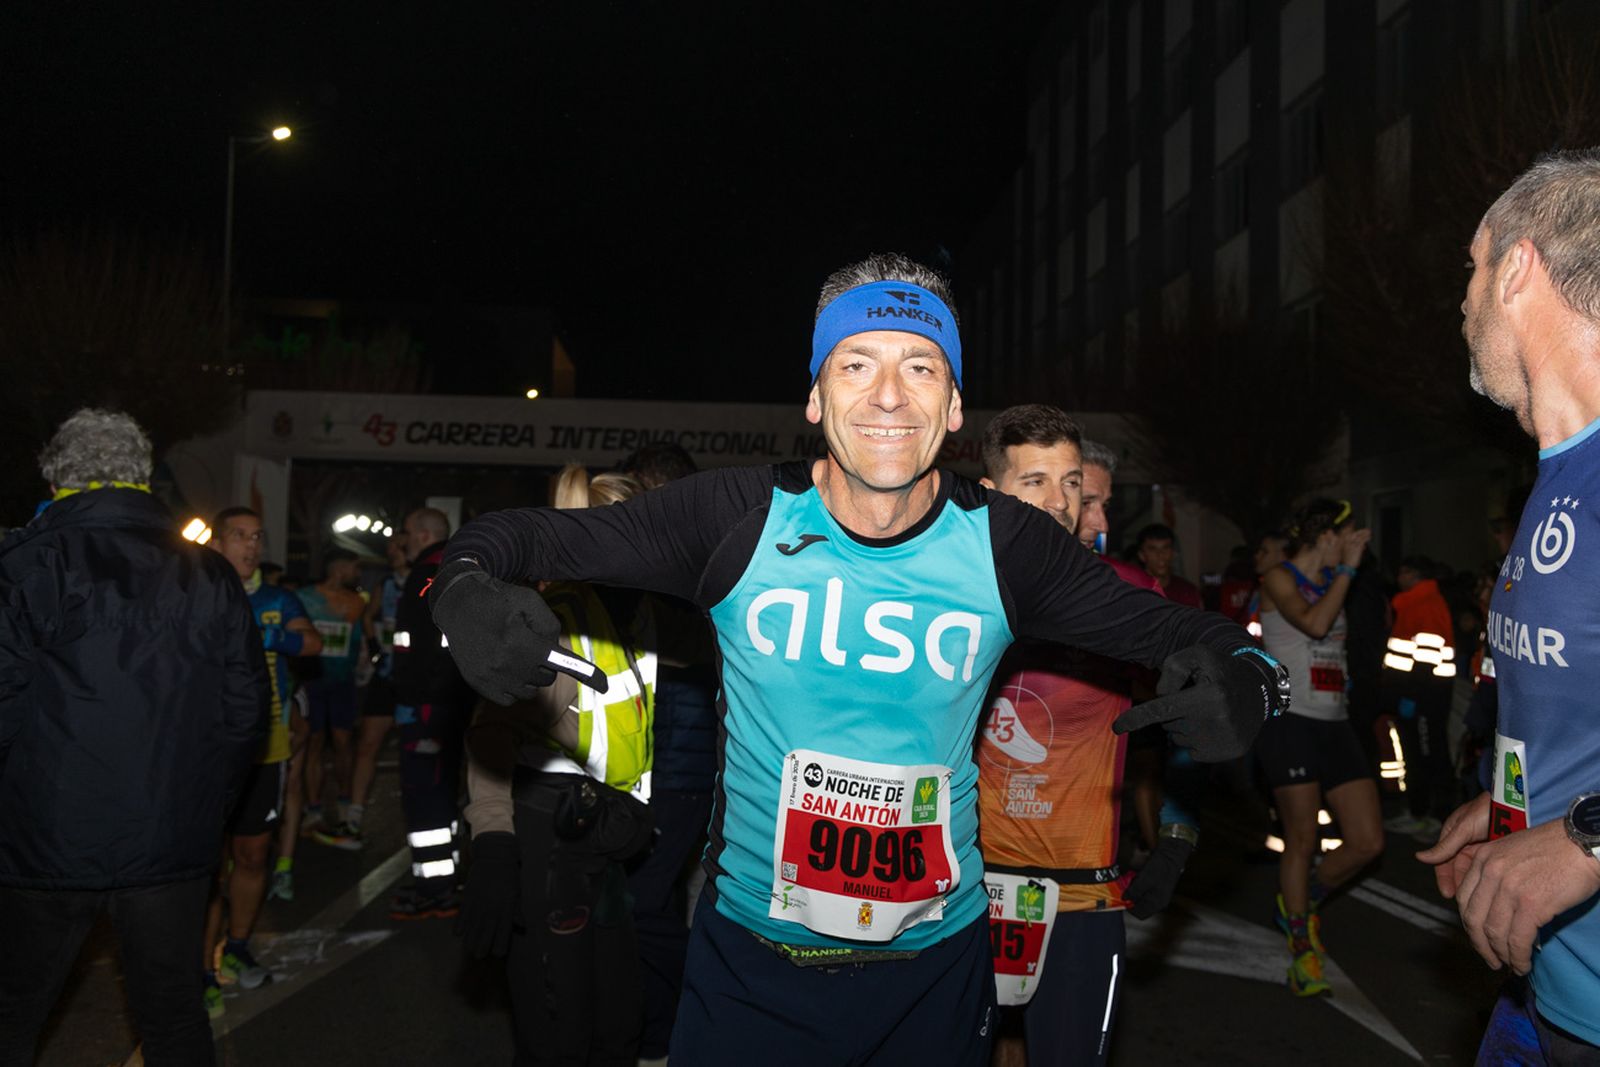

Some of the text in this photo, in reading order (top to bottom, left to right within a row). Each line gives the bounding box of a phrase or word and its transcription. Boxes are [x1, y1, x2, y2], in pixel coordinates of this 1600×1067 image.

[867, 306, 943, 332] HANKER
[362, 413, 398, 447] 43
[405, 421, 536, 447] CARRERA
[546, 426, 782, 456] INTERNACIONAL
[1512, 555, 1526, 581] 28
[746, 576, 982, 683] alsa
[1488, 609, 1570, 667] ULEVAR
[986, 707, 1015, 743] 43
[825, 776, 905, 803] NOCHE DE
[826, 768, 905, 786] CARRERA URBANA INTERNACIONAL
[1008, 788, 1035, 801] SAN
[801, 792, 901, 826] SAN ANTÓN
[807, 818, 927, 884] 9096
[843, 881, 894, 900] MANUEL
[990, 887, 1004, 901] DE
[801, 948, 853, 957] HANKER
[990, 922, 1025, 961] 15
